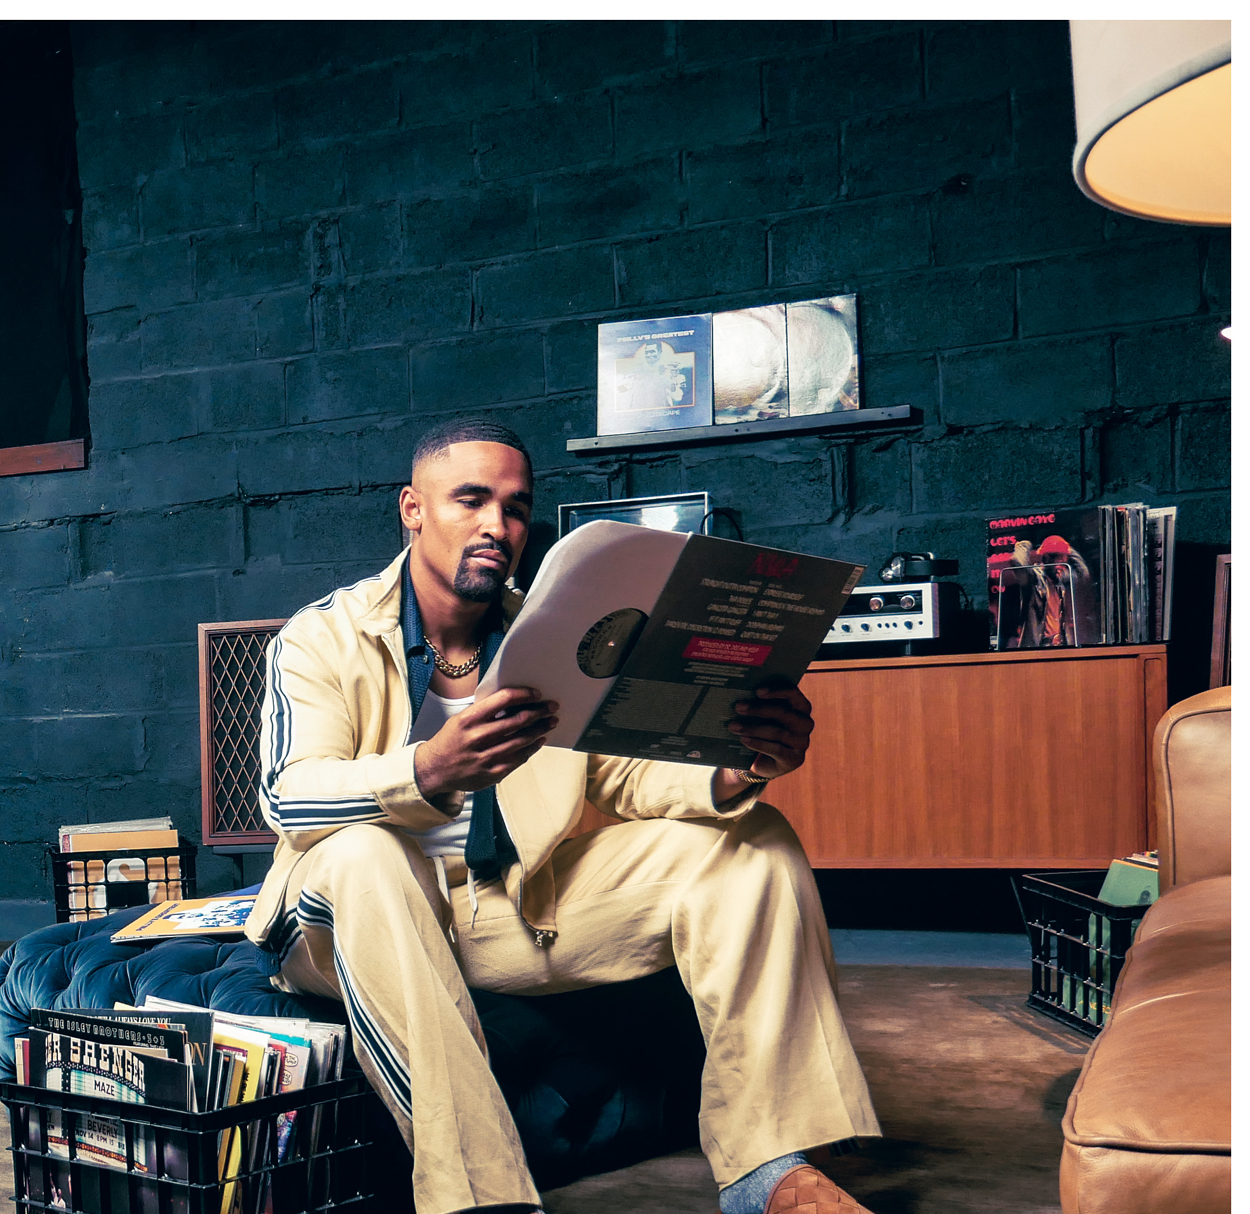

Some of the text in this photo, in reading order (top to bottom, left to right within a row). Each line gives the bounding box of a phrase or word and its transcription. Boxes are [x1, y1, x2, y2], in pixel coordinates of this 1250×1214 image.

[651, 330, 695, 339] GREATEST
[48, 1016, 65, 1031] THE
[67, 1021, 91, 1035] ISLEY
[94, 1080, 115, 1097] MAZE
[87, 1119, 118, 1139] BEVERLY
